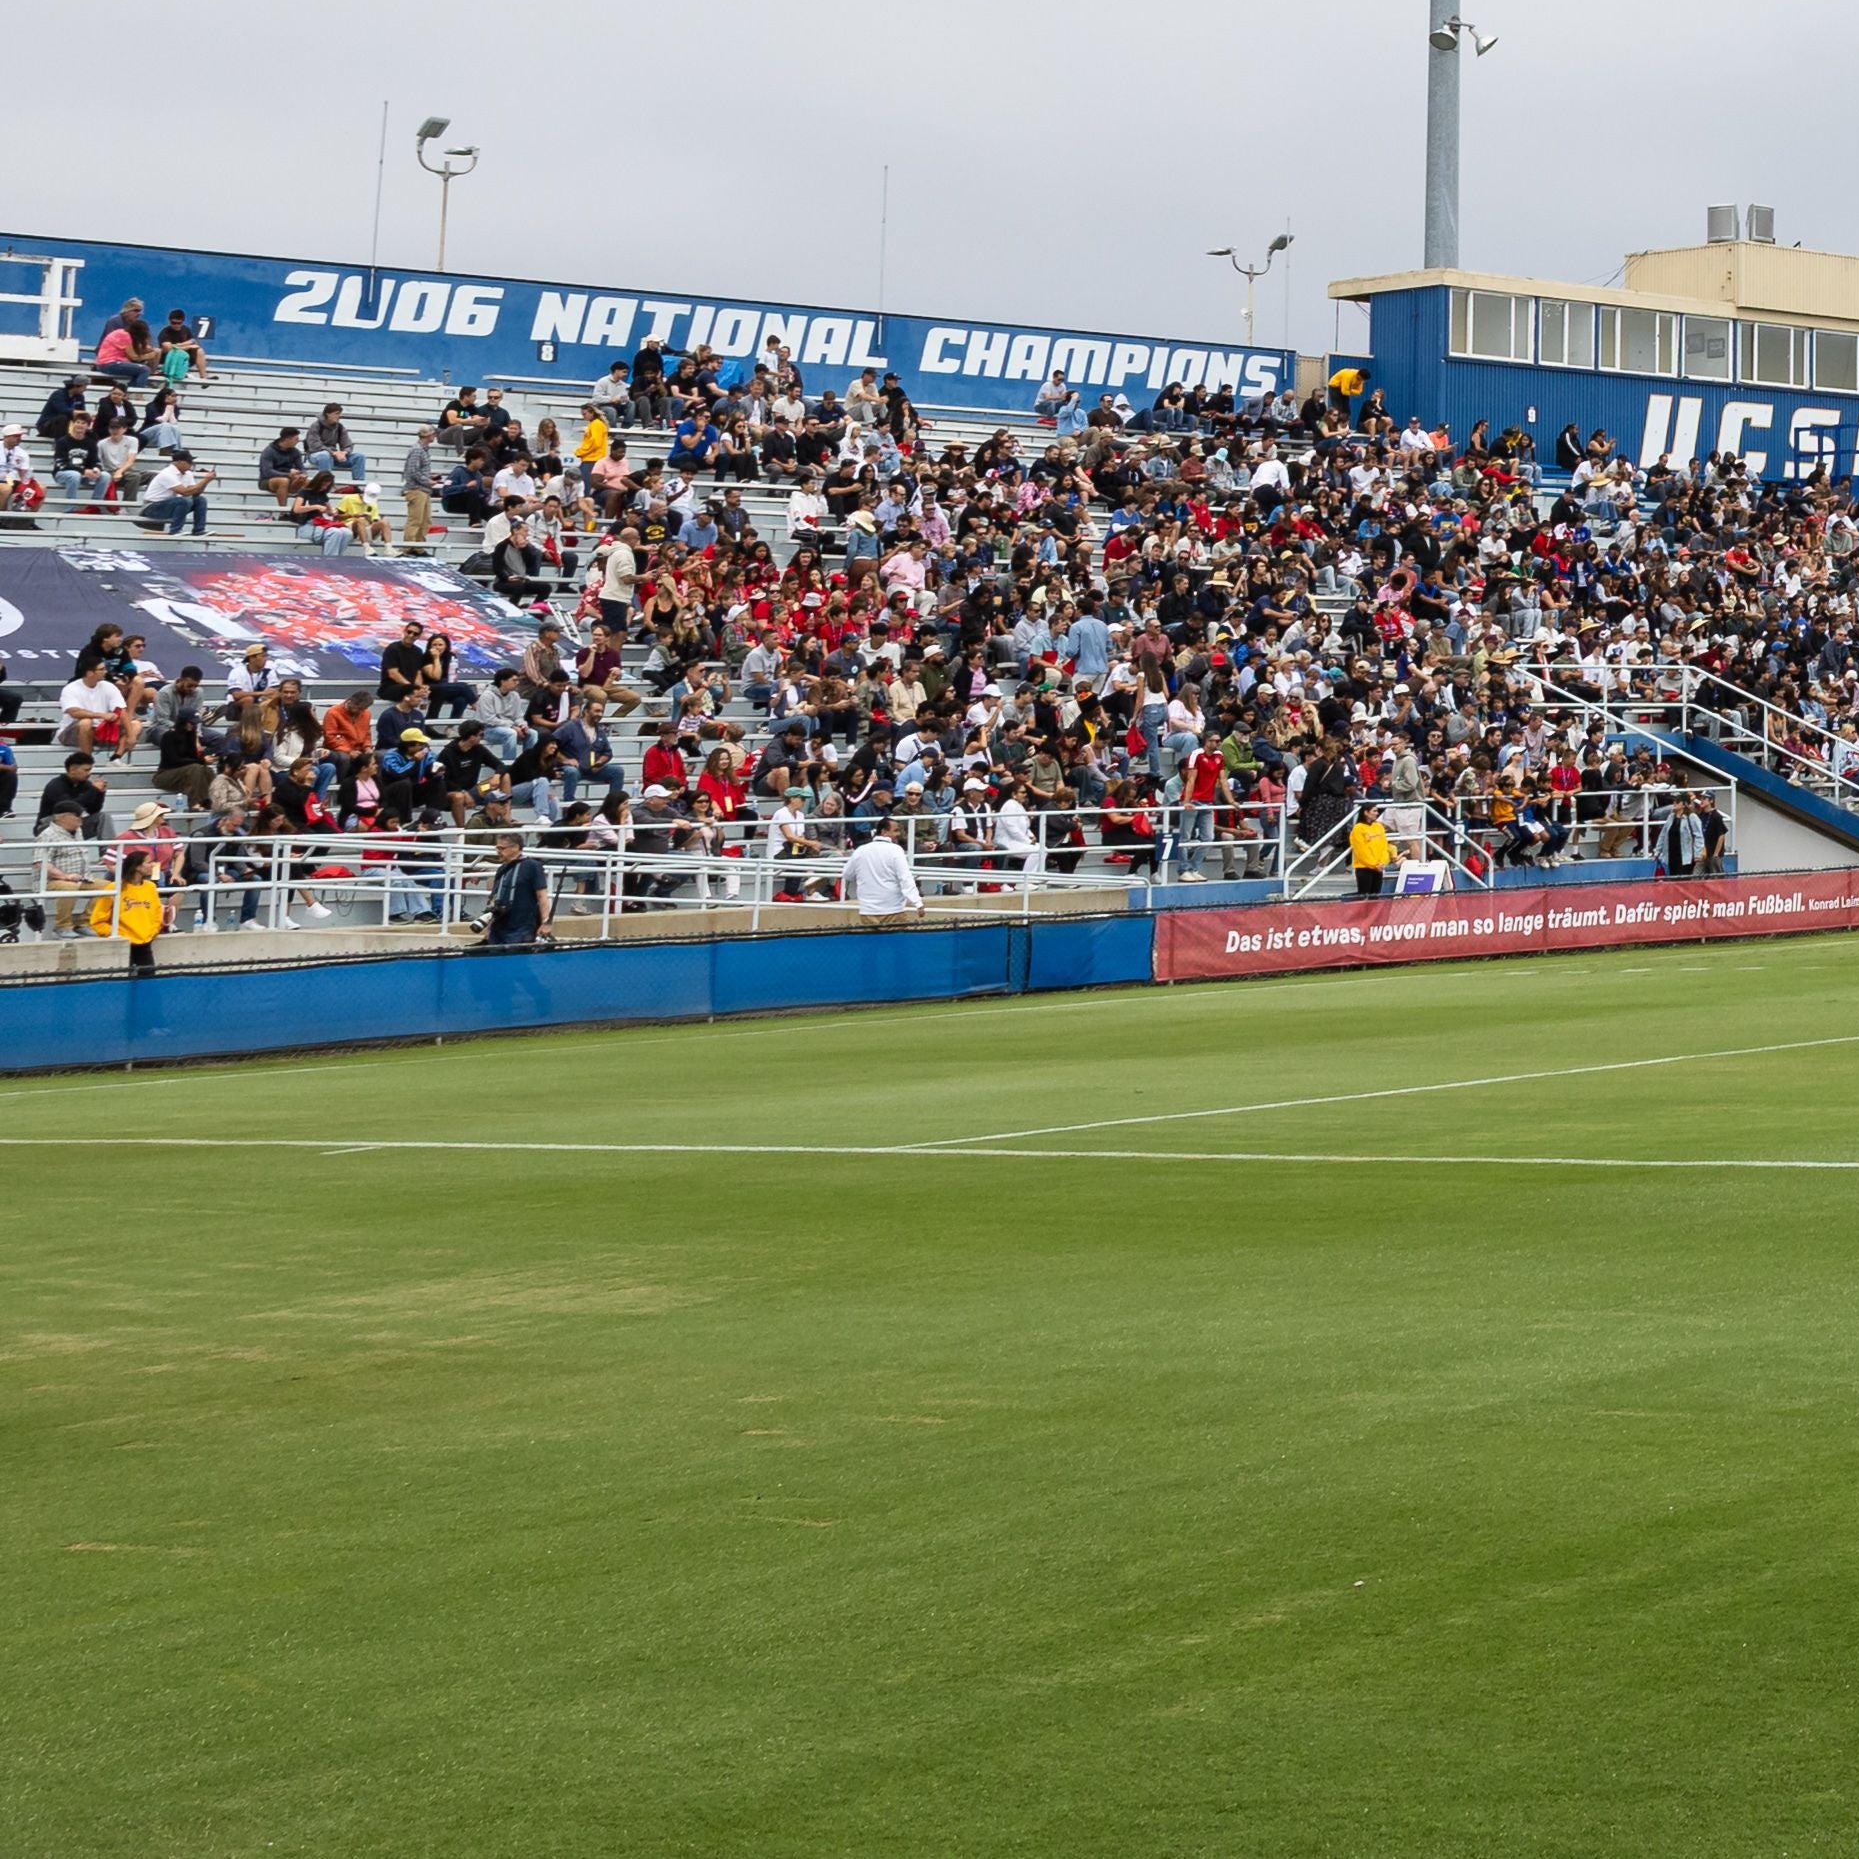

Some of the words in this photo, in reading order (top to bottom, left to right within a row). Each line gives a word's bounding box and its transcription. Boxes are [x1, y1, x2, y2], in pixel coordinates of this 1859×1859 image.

[198, 320, 210, 338] 7
[530, 291, 888, 368] NATIONAL
[919, 327, 1281, 398] CHAMPIONS
[541, 345, 553, 361] 8
[1161, 838, 1173, 859] 7
[1225, 930, 1262, 954] Das
[1266, 926, 1295, 950] ist
[1297, 924, 1366, 947] etwas,
[1369, 921, 1426, 943] wovon
[1430, 918, 1469, 938] man
[1473, 917, 1495, 936] so
[1498, 912, 1544, 937] lange
[1547, 906, 1611, 929] träumt.
[1615, 902, 1661, 925] Dafür
[1663, 898, 1710, 925] spielt
[1712, 900, 1745, 918] man
[1748, 892, 1806, 916] Fußball.
[1808, 896, 1840, 912] Konrad
